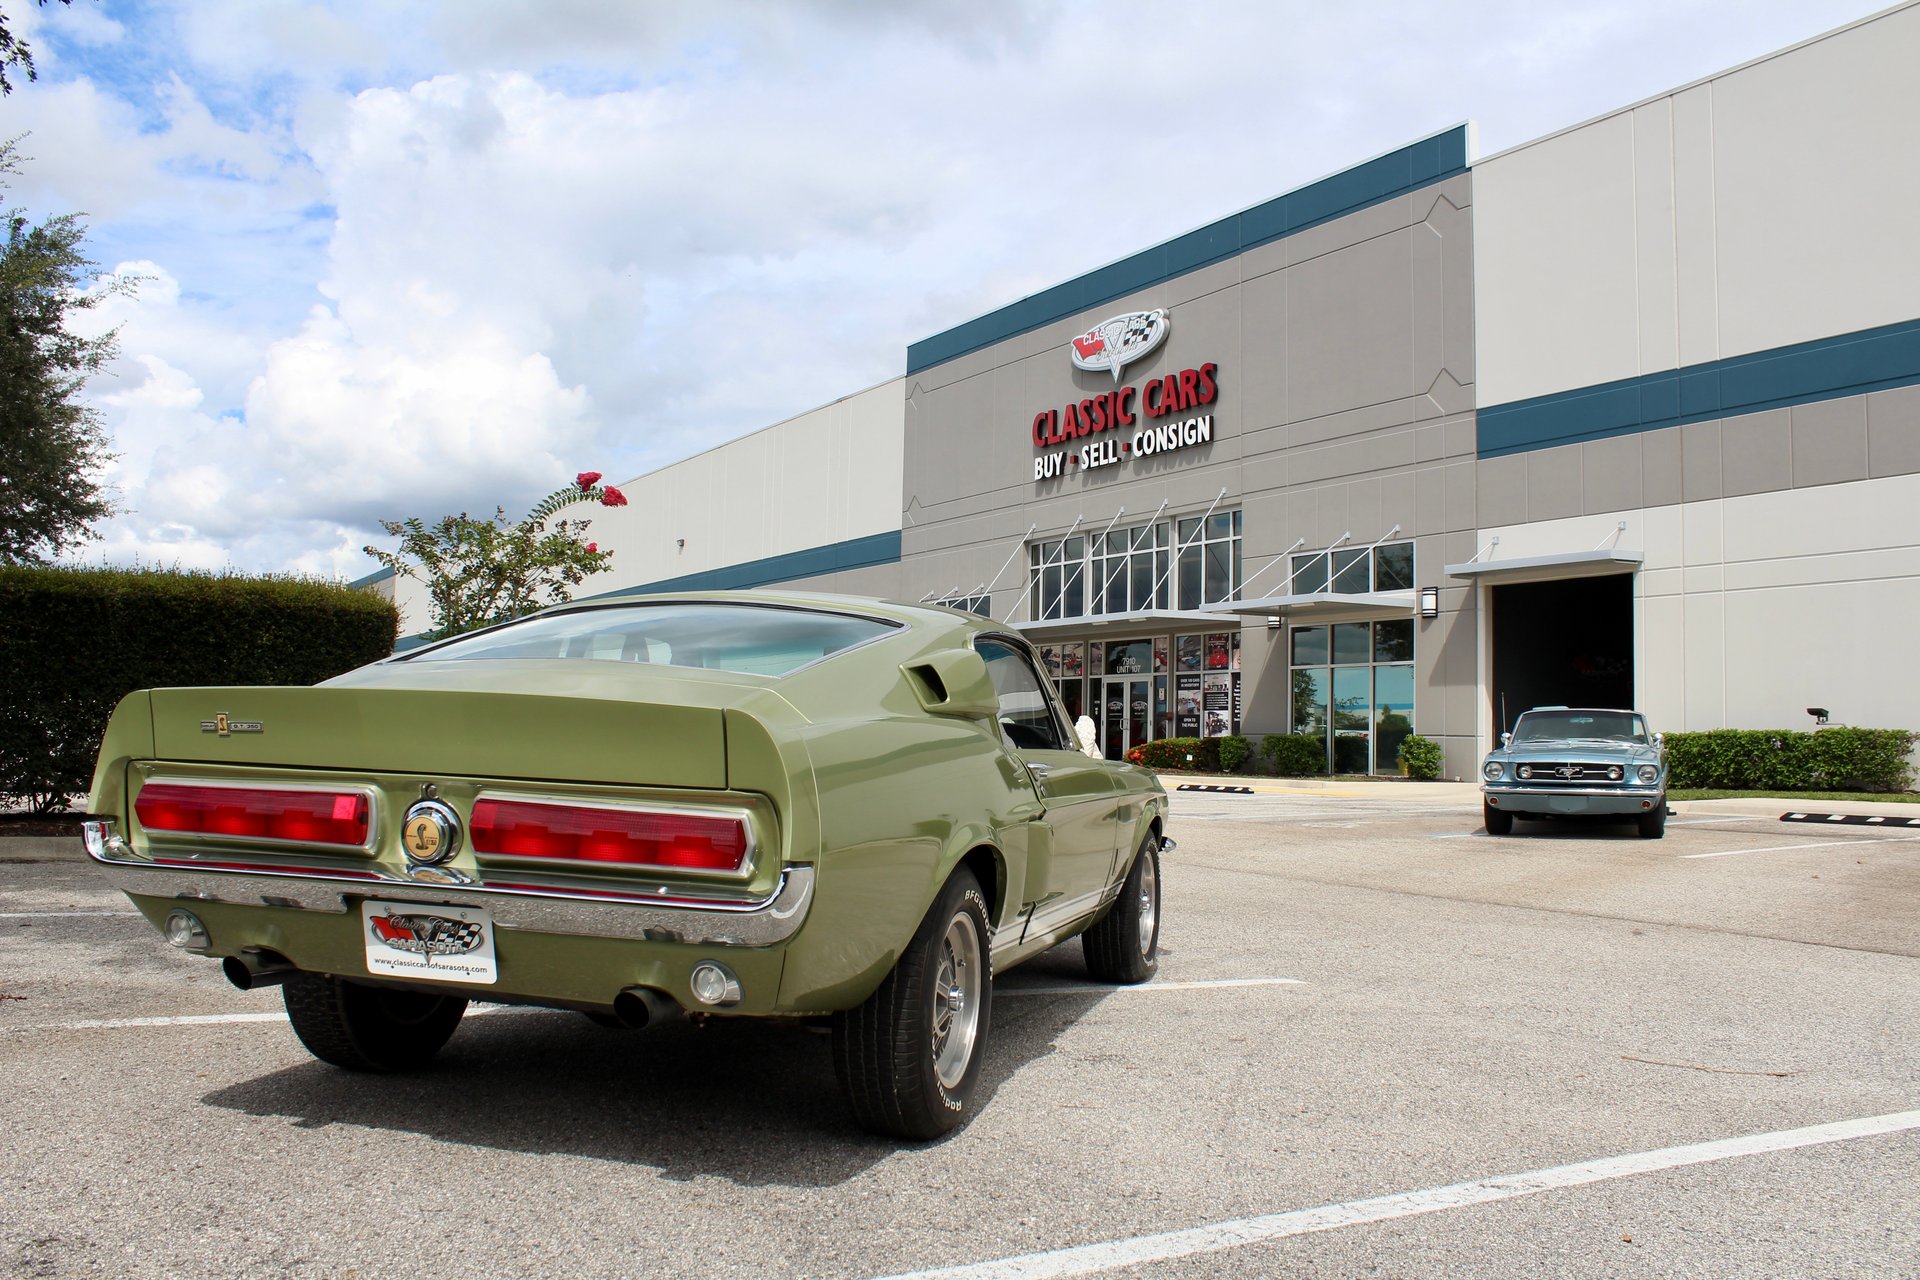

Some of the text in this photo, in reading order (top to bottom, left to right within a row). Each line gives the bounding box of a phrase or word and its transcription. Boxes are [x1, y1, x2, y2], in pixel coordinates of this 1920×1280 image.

[1083, 316, 1147, 346] CLASSIC CARS
[1032, 362, 1217, 448] CLASSIC CARS
[1034, 415, 1212, 480] BUY SELL CONSIGN
[1116, 664, 1142, 674] UNIT 107
[1122, 657, 1136, 666] 7910
[387, 913, 426, 932] Classic
[385, 937, 466, 953] SARASOTA
[374, 957, 488, 974] www.classiccarsofsarasota.com
